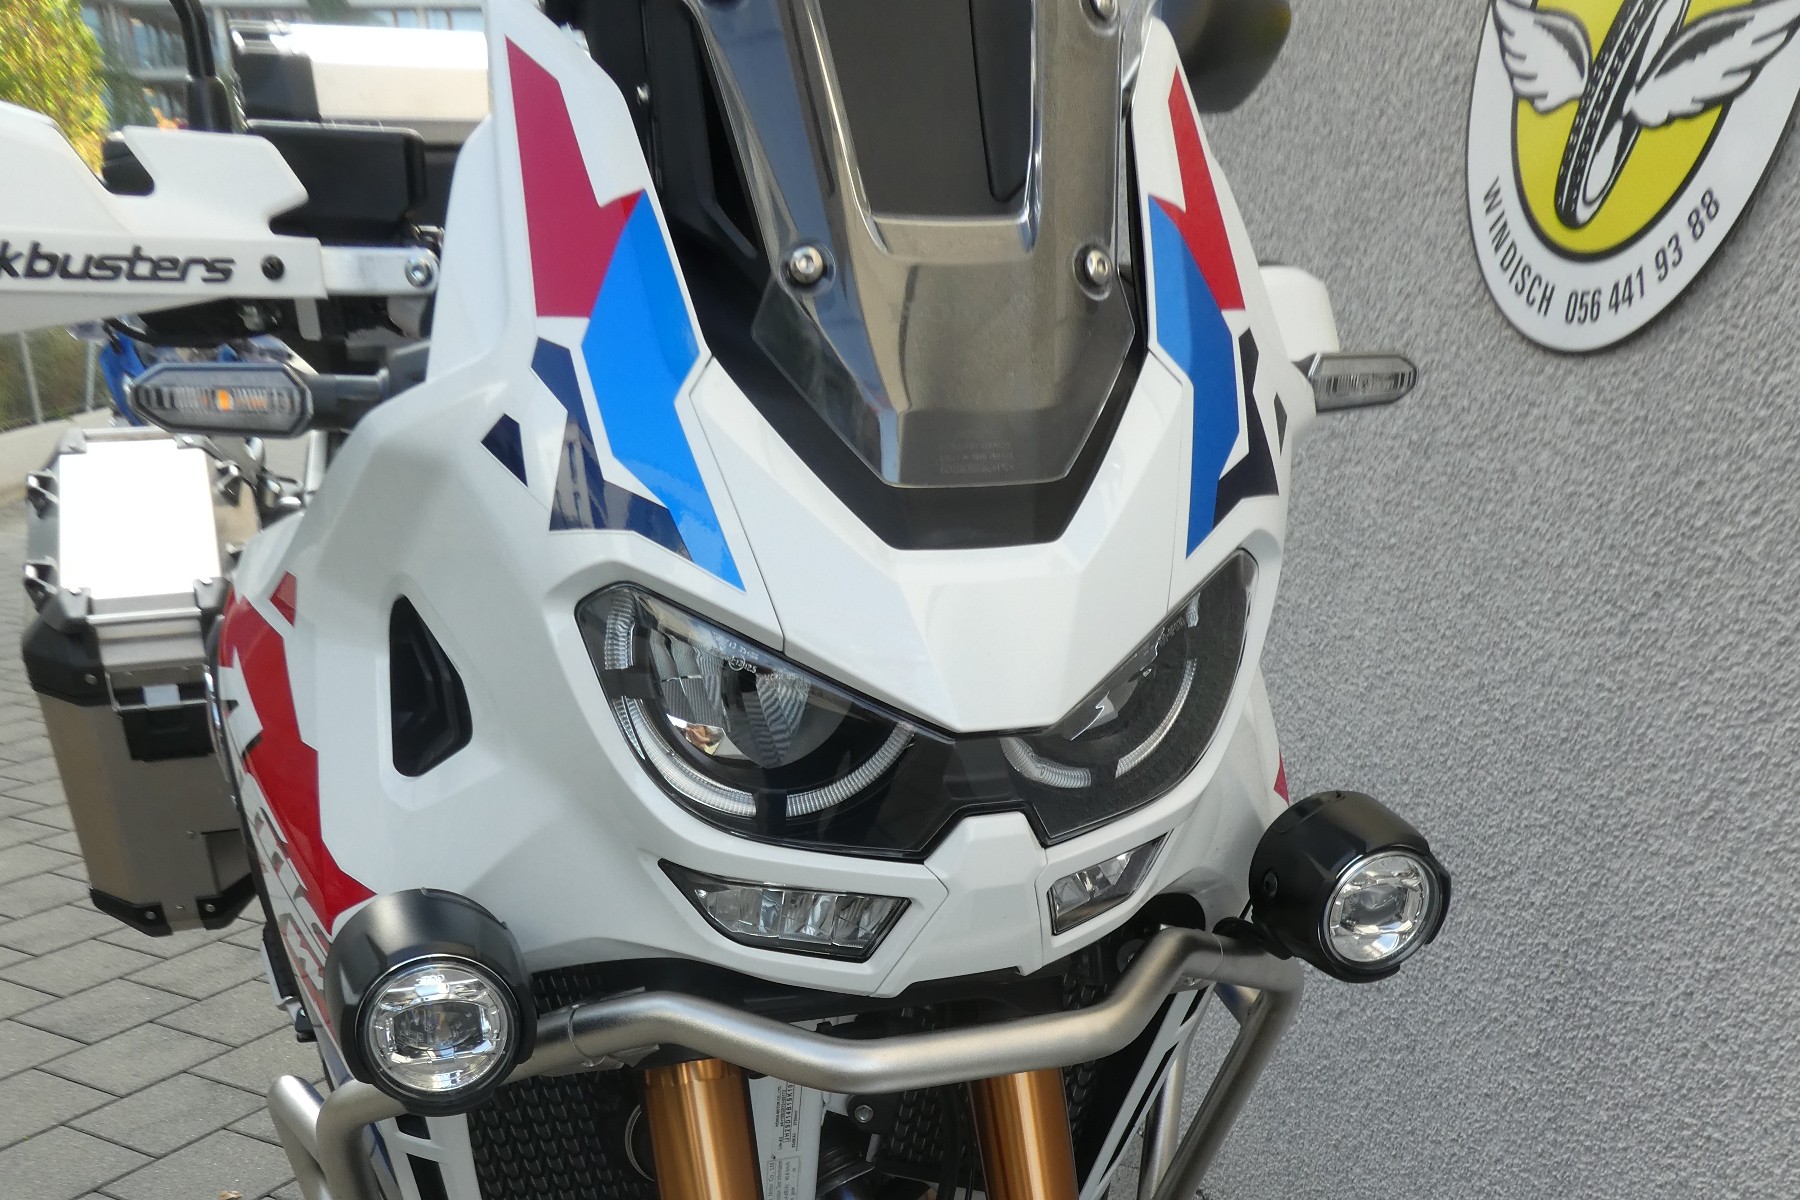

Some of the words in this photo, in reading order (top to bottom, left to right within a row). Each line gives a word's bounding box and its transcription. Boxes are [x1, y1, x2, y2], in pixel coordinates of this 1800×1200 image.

[0, 240, 235, 283] kbusters
[1484, 175, 1555, 317] WINDISCH
[1565, 288, 1602, 325] 056
[1608, 265, 1645, 315] 441
[1655, 232, 1683, 282] 93
[1687, 187, 1720, 241] 88
